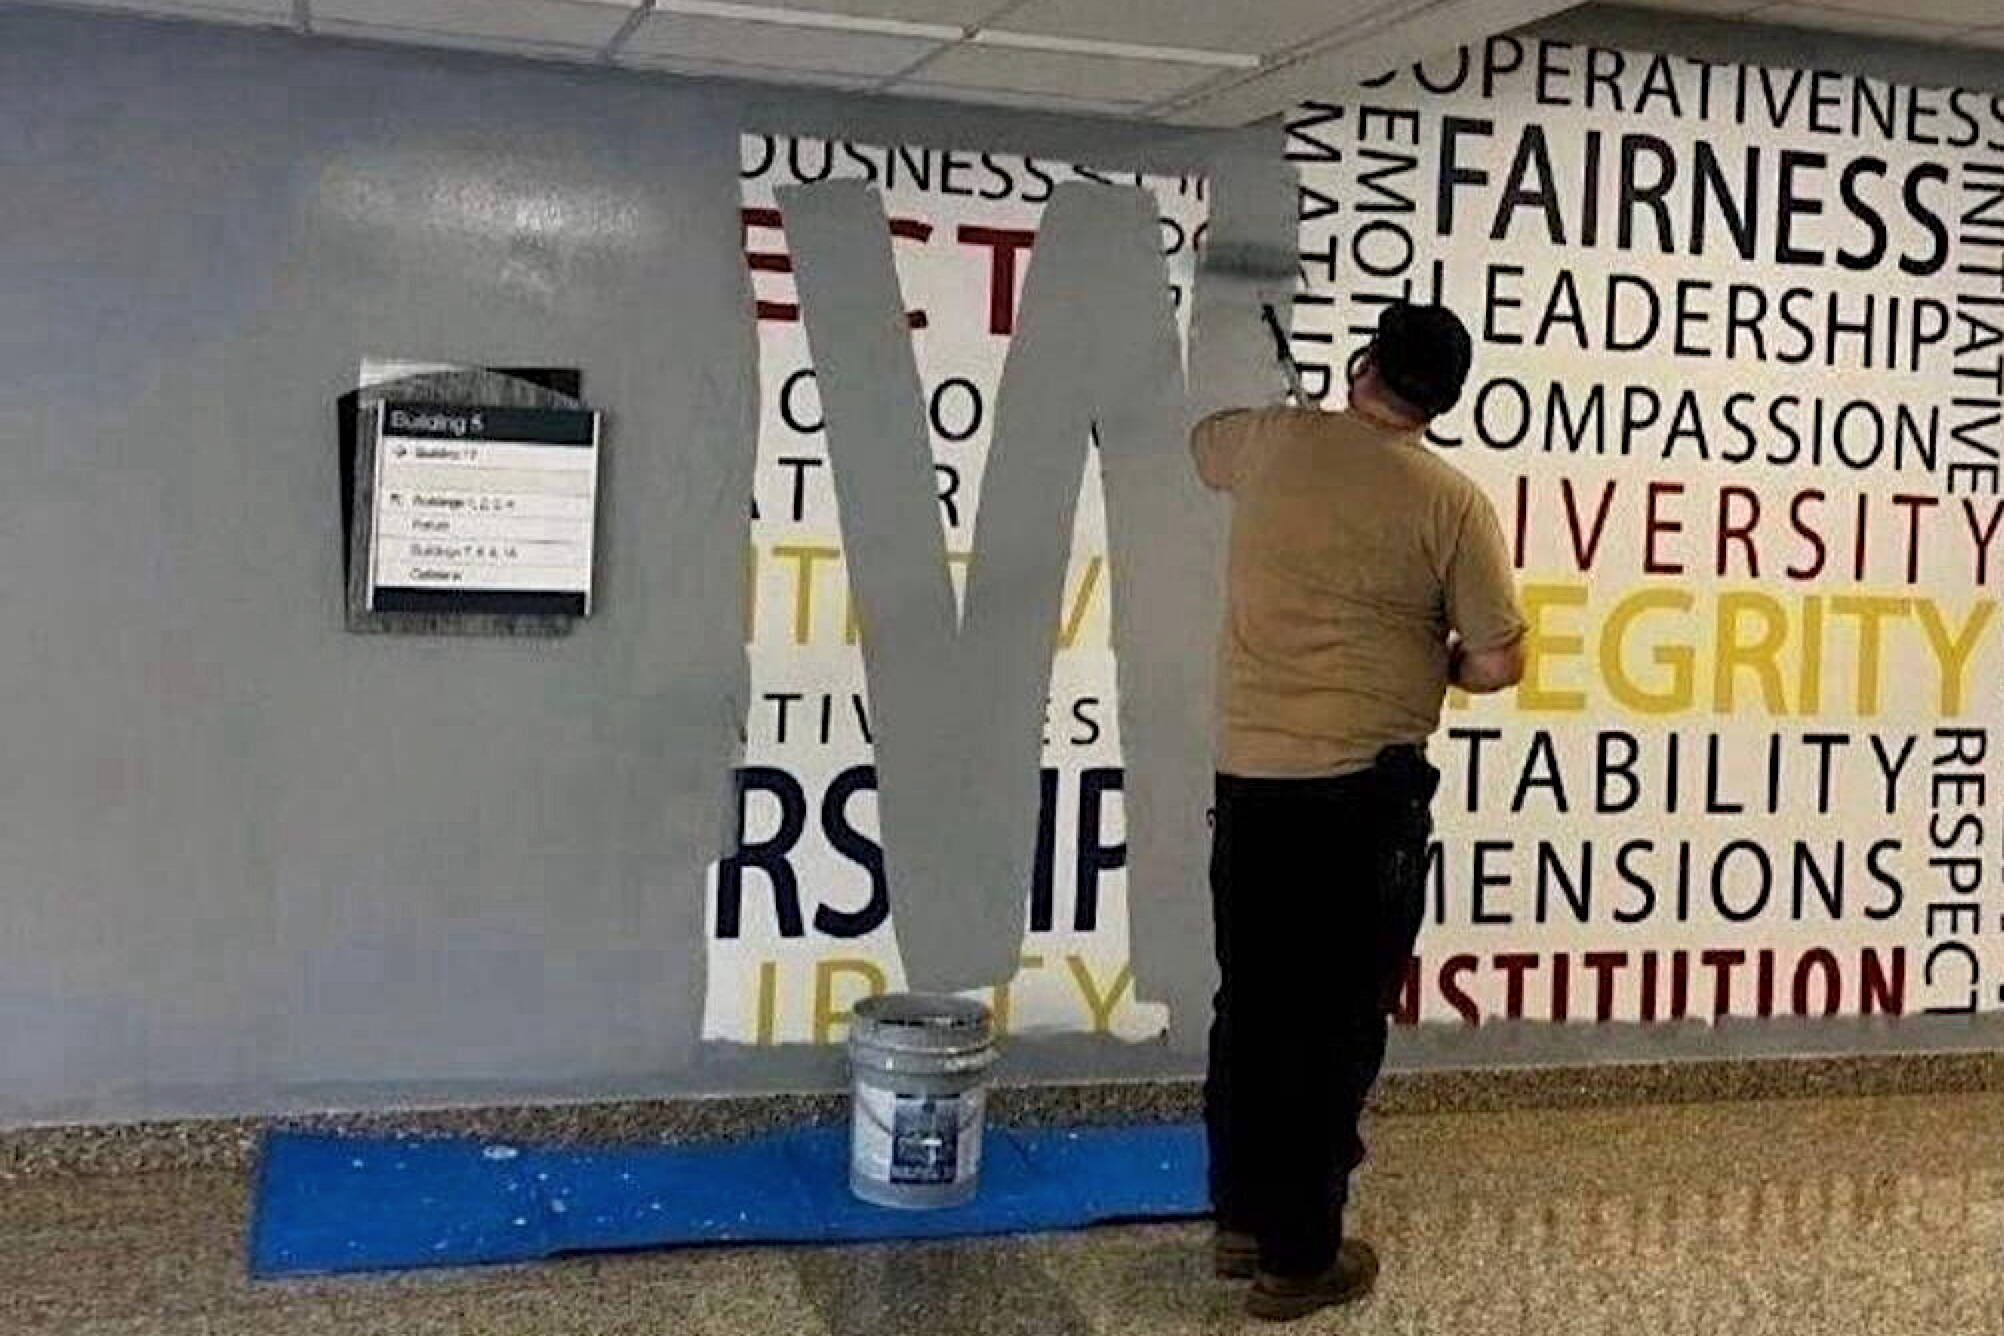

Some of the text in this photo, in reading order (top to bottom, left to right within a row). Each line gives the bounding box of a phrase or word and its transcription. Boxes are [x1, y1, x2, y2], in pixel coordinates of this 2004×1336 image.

[1436, 115, 1950, 276] FAIRNESS
[1513, 475, 2004, 586] IVERSITY
[1447, 582, 1996, 718] EGRITY
[1448, 727, 1918, 816] TABILITY
[1923, 728, 1987, 1014] RESPECT
